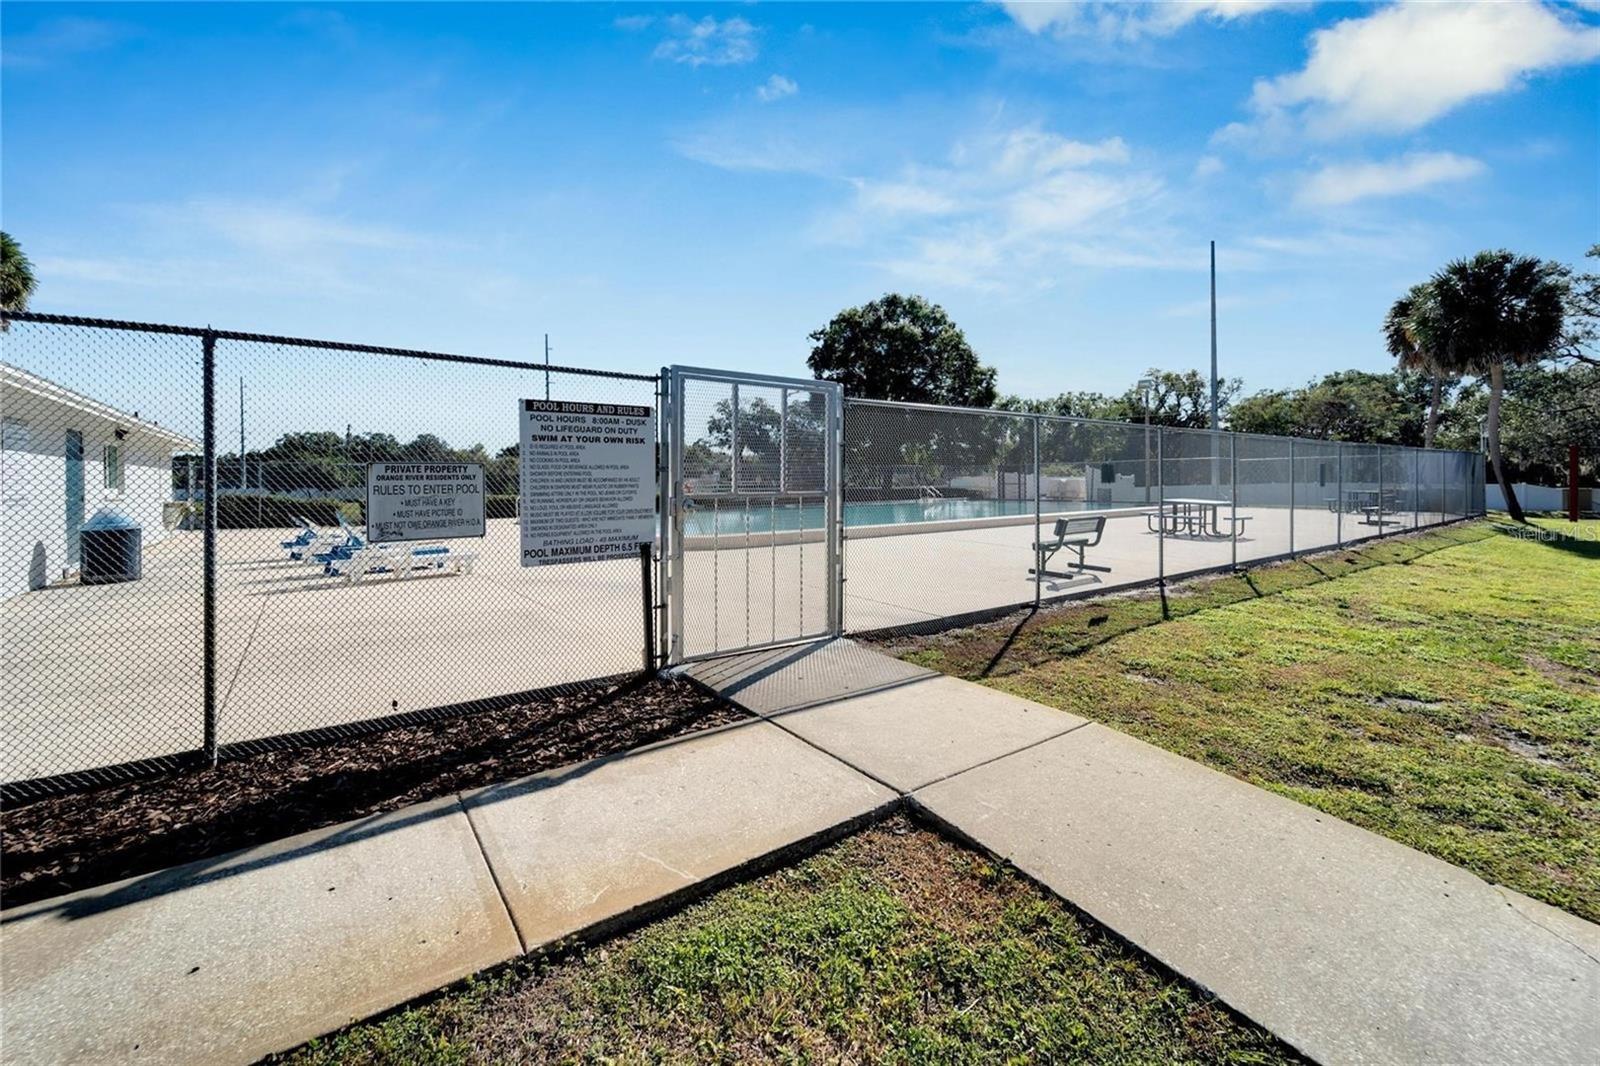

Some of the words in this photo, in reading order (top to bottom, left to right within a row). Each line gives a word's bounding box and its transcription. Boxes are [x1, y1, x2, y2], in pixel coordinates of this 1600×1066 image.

[532, 402, 560, 410] POOL
[562, 403, 594, 413] HOURS
[596, 405, 615, 414] AND
[618, 406, 645, 416] RULES
[530, 414, 554, 422] POOL
[556, 415, 586, 424] HOURS
[592, 417, 620, 425] 8:00AM
[626, 418, 647, 426] DUSK
[556, 425, 602, 434] LIFEGUARD
[384, 465, 422, 473] PRIVATE
[424, 465, 468, 473] PROPERTY
[372, 484, 405, 495] RULES
[408, 484, 420, 495] TO
[423, 484, 453, 494] ENTER
[456, 484, 480, 494] POOL
[444, 498, 455, 506] KEY
[432, 509, 455, 517] PICTURE
[394, 521, 406, 529] NOT
[524, 549, 548, 558] POOL
[551, 546, 591, 556] MAXIMUM
[594, 544, 620, 553] DEPTH
[622, 543, 632, 551] 6.5
[539, 557, 581, 565] TRESPASSERS
